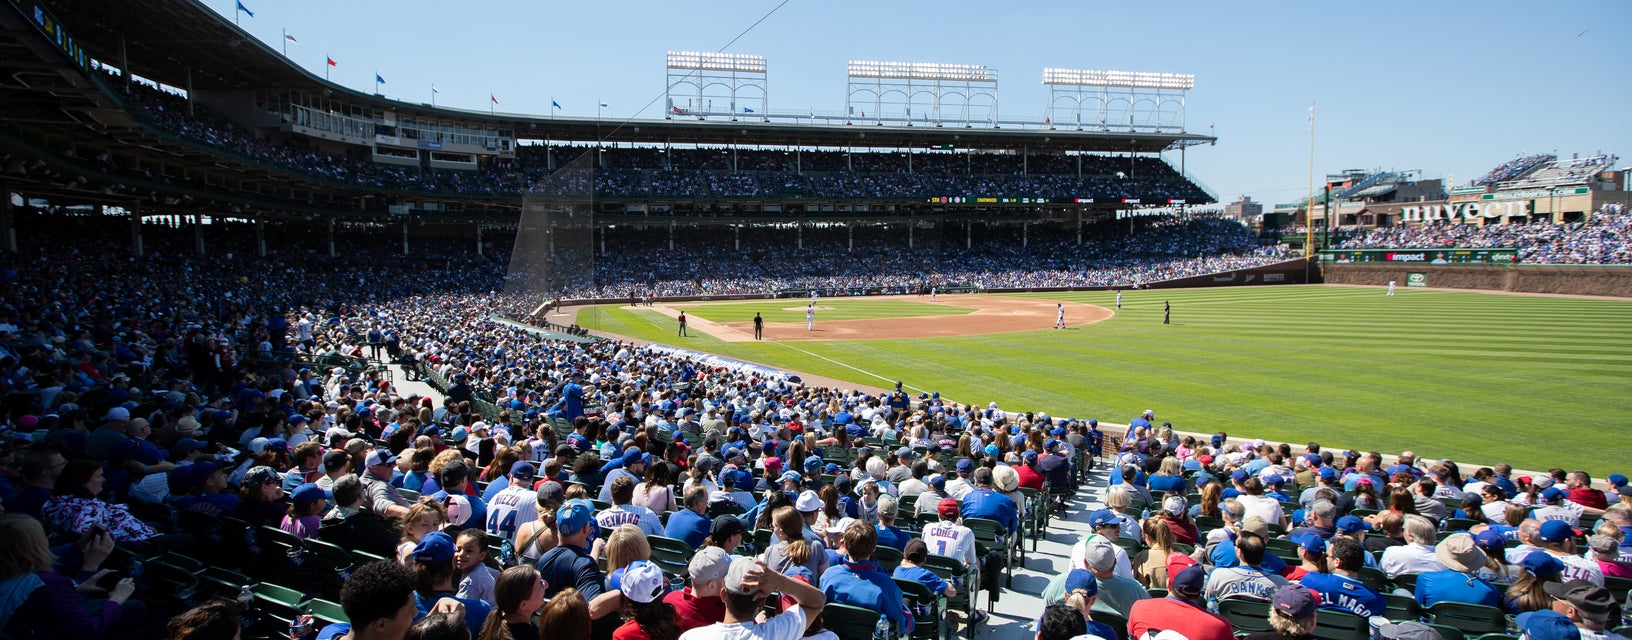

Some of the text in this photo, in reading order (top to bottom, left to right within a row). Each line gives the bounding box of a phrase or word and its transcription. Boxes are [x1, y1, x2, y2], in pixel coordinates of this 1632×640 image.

[1392, 252, 1425, 262] impact
[537, 451, 549, 461] 17
[488, 509, 517, 539] 44
[931, 527, 958, 540] COHEN
[937, 540, 946, 555] 1
[1231, 580, 1273, 597] BANKS
[1318, 592, 1371, 617] EL MAGO
